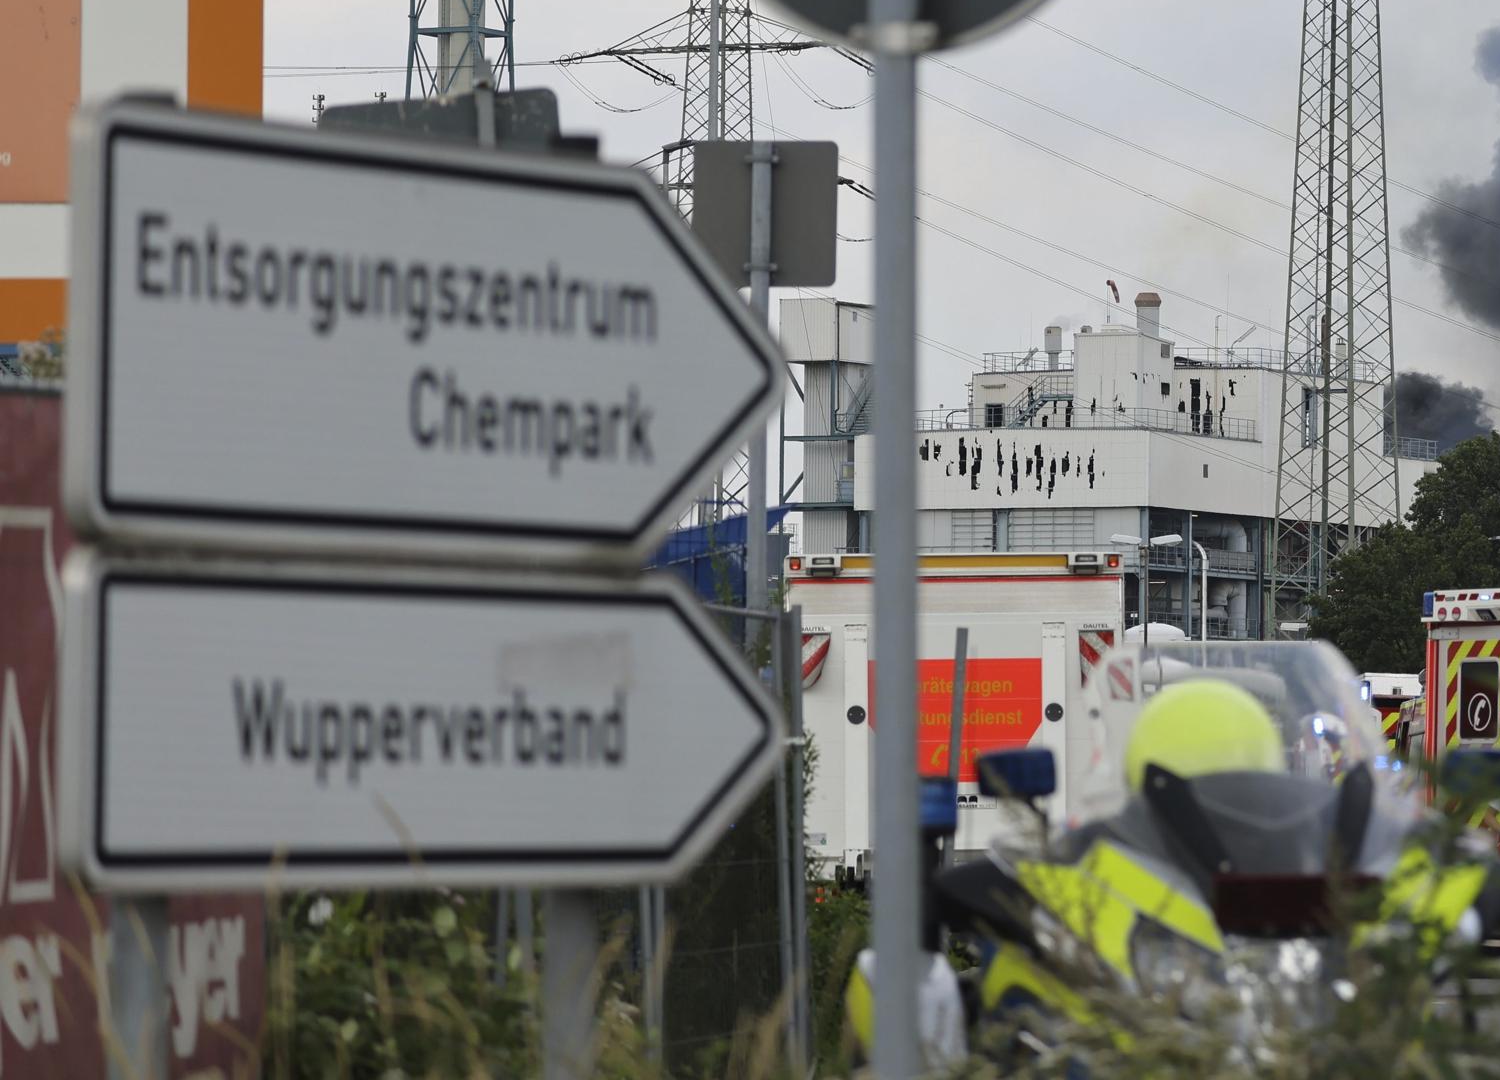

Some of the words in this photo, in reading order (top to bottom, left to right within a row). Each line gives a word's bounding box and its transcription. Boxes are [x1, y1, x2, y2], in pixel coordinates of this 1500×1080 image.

[136, 211, 660, 344] Entsorgungszentrum
[410, 367, 656, 476] Chempark
[232, 677, 627, 787] Wupperverband
